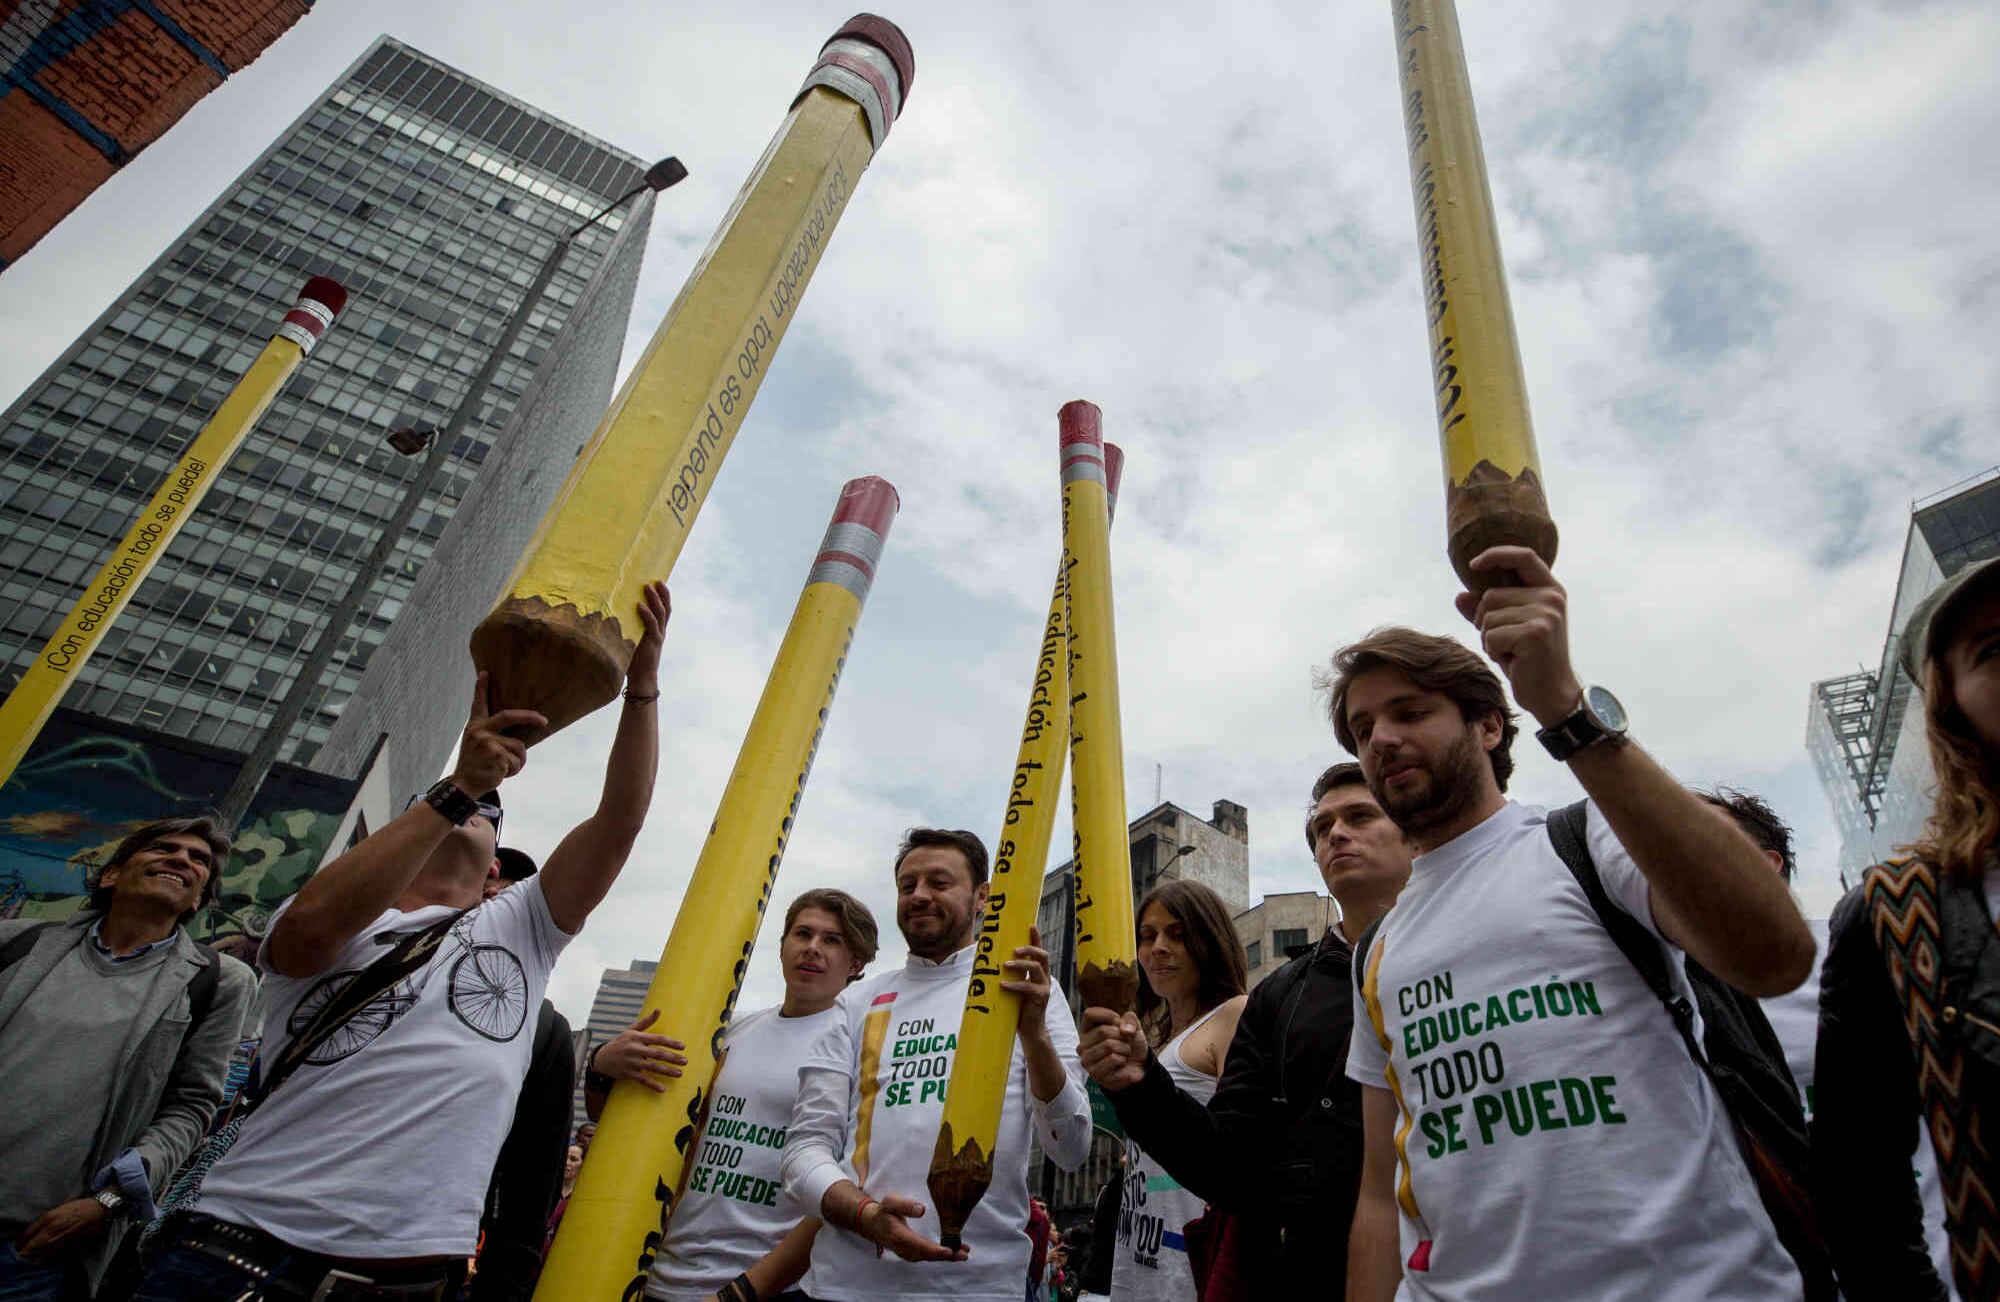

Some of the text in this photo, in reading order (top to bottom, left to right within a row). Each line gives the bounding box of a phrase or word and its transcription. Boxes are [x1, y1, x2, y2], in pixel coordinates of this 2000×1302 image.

[770, 207, 825, 319] educación
[738, 316, 774, 380] todo
[719, 374, 741, 416] se
[666, 402, 724, 528] puede!
[47, 457, 207, 673] ¡Con educación todo se puede!
[966, 611, 1067, 1015] educación todo se puede!
[1398, 971, 1455, 1017] CON
[897, 1018, 935, 1037] CON
[1403, 975, 1603, 1060] EDUCACIÓN
[892, 1033, 957, 1058] EDUCA
[891, 1056, 948, 1082] TODO
[1411, 1041, 1505, 1105] TODO
[716, 1094, 747, 1116] CON
[884, 1081, 915, 1108] SE
[707, 1116, 789, 1150] EDUCACIÓ
[1420, 1075, 1627, 1159] SE PUEDE
[700, 1141, 744, 1169] TODO
[690, 1165, 782, 1208] SE PUEDE
